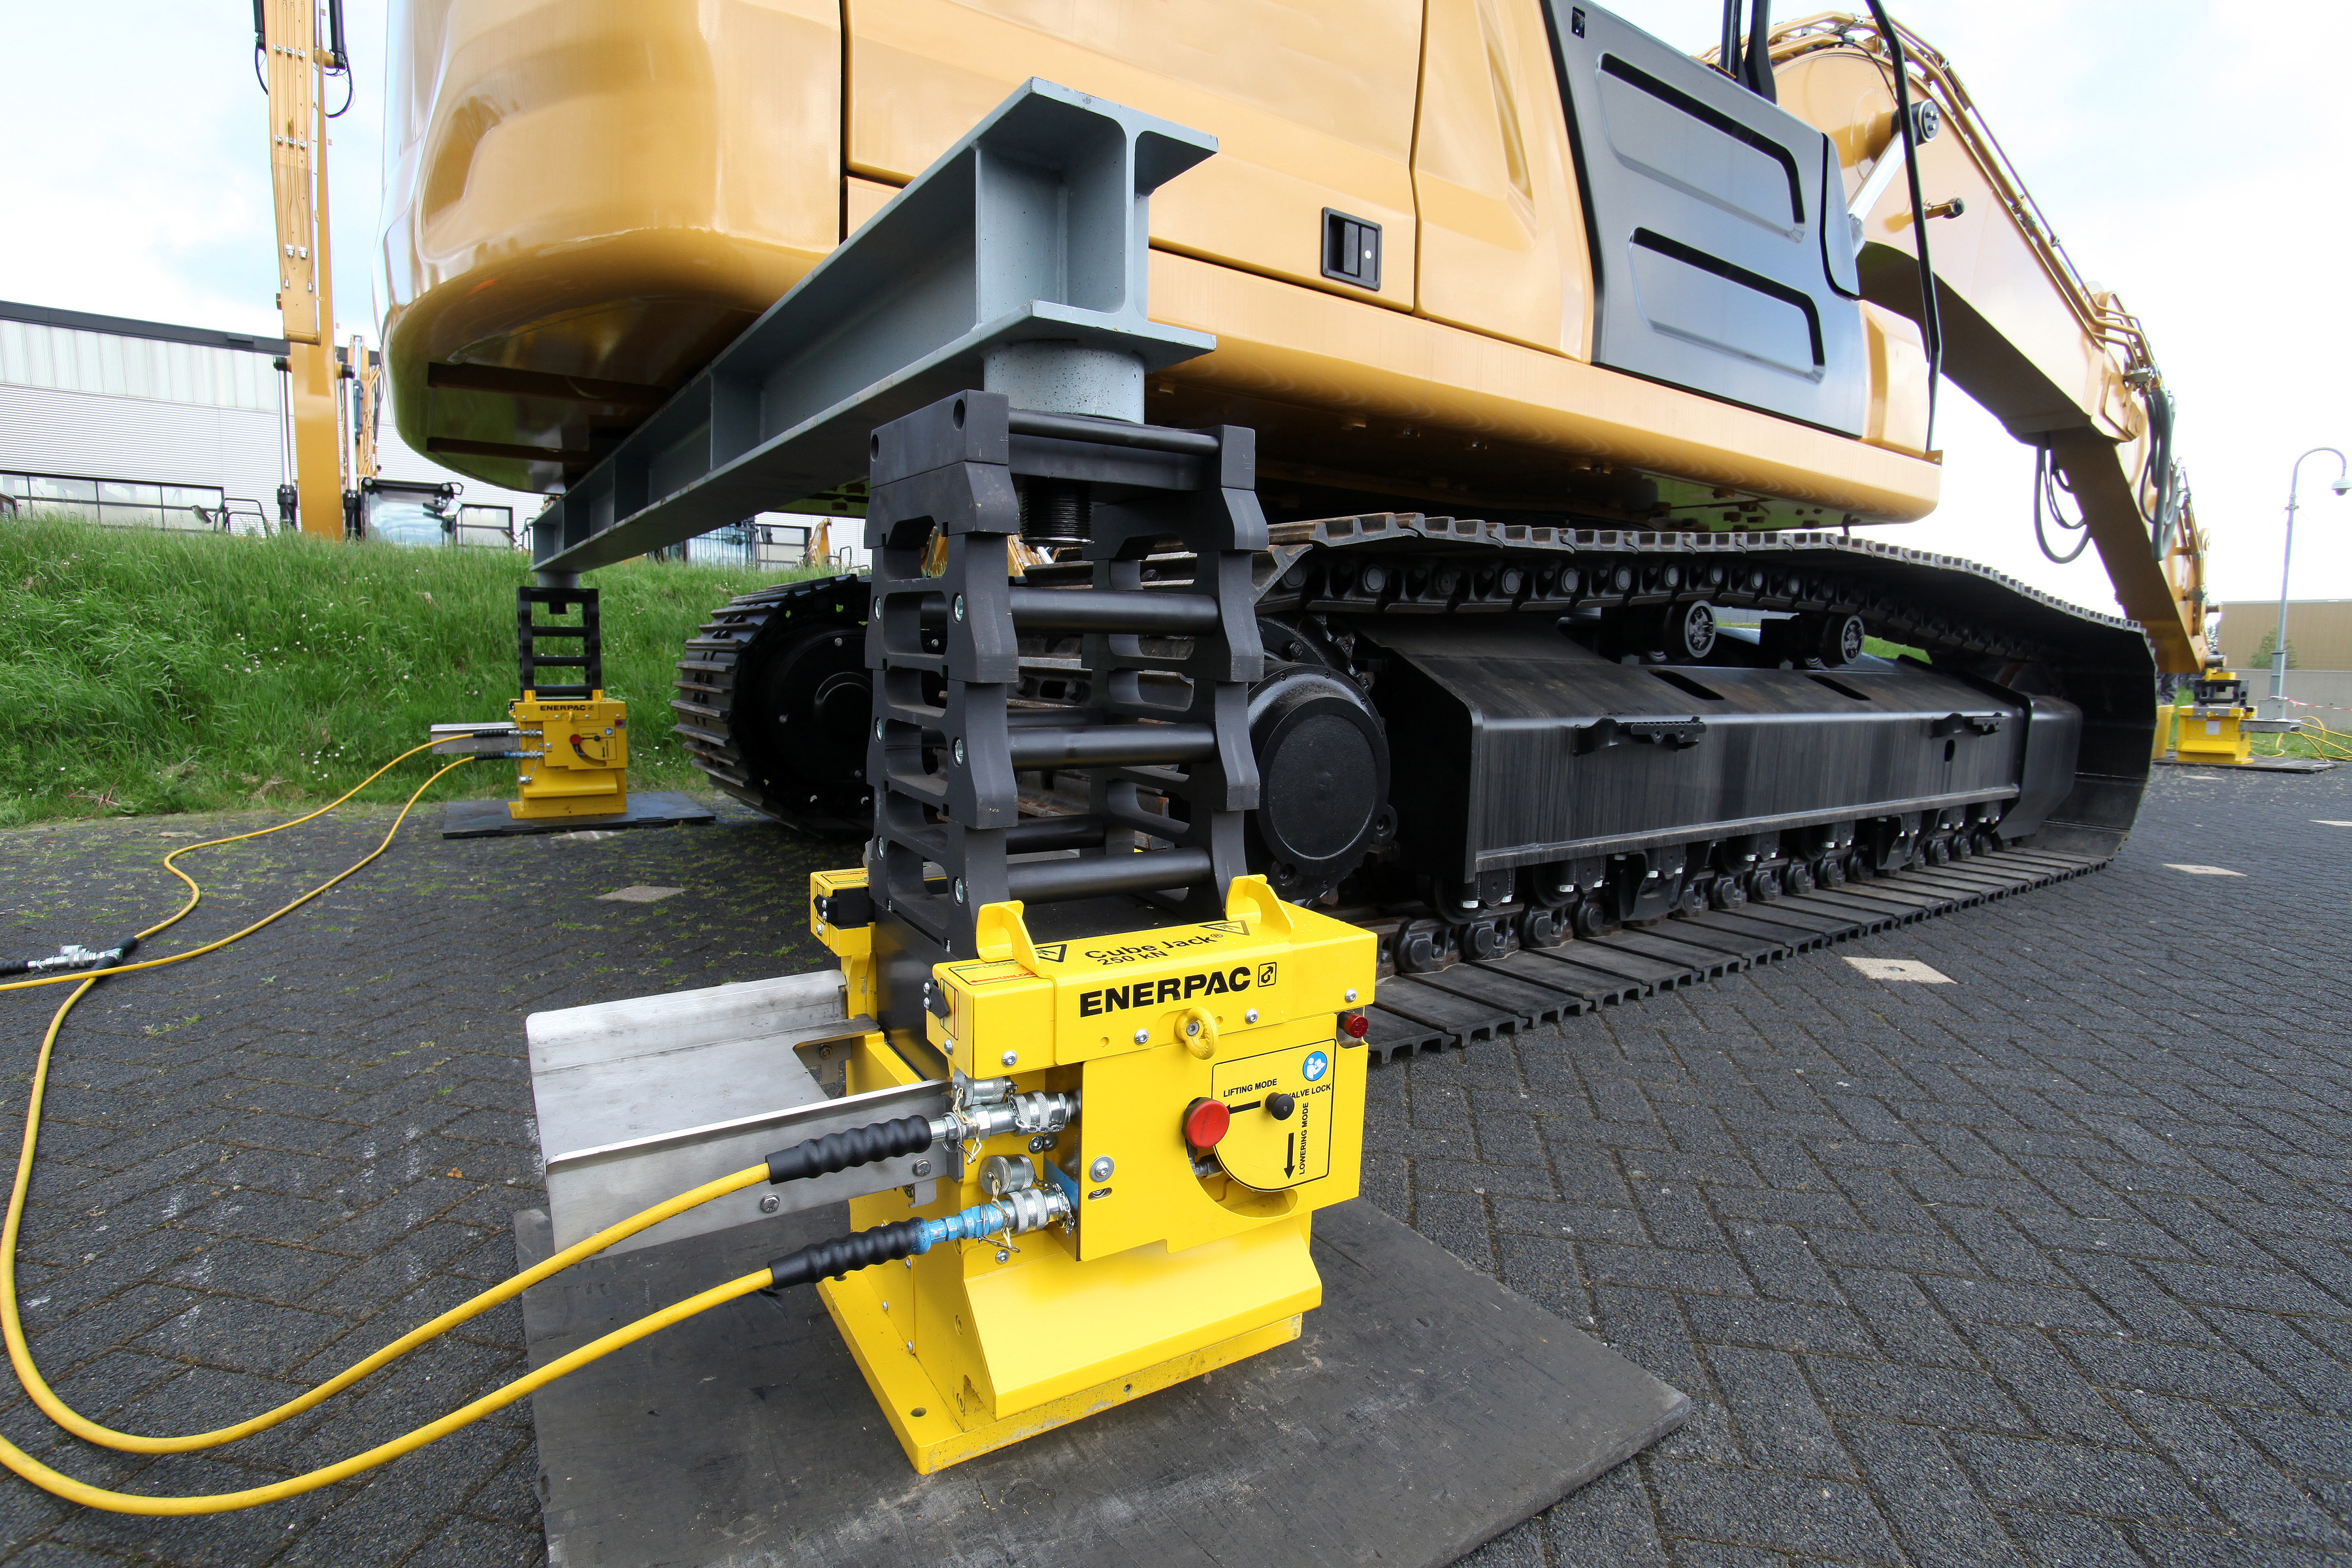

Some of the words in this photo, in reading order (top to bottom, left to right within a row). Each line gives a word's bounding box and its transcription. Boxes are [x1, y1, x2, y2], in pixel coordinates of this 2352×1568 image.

[1085, 943, 1158, 959] Cube
[1097, 955, 1135, 966] 250
[1139, 951, 1169, 959] kN
[1080, 966, 1251, 1018] ENERPAC
[1223, 1085, 1253, 1098] LIFTING
[1254, 1079, 1277, 1090] MODE
[1311, 1083, 1331, 1094] LOCK
[1299, 1130, 1307, 1175] LOWERING
